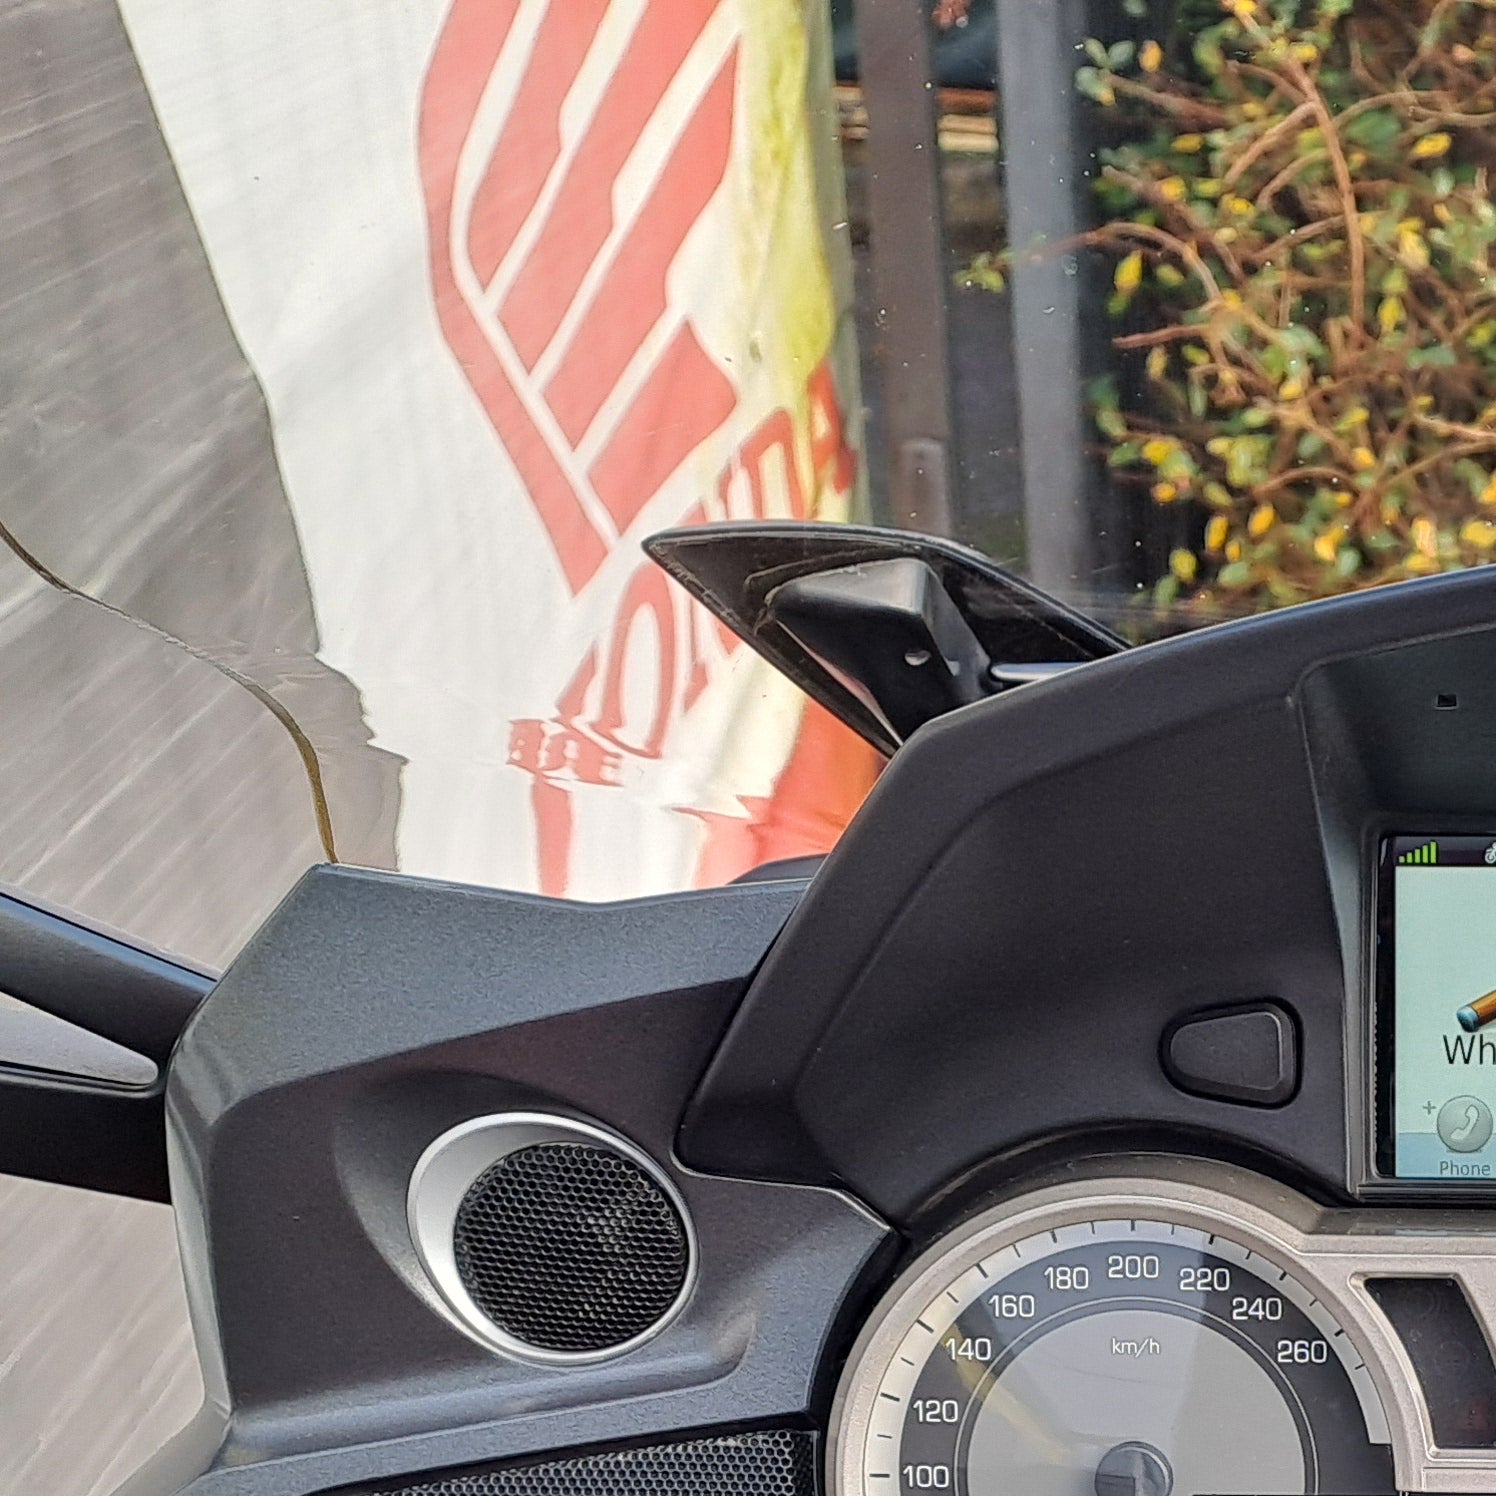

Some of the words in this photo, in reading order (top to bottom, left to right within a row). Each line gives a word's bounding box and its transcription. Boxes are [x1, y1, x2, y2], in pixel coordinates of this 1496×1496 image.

[1439, 1160, 1491, 1176] Phone
[1044, 1267, 1089, 1290] 180
[1108, 1256, 1159, 1279] 200
[1179, 1268, 1230, 1291] 220
[989, 1295, 1035, 1318] 160
[1232, 1298, 1281, 1321] 240
[946, 1338, 991, 1361] 140
[1112, 1338, 1161, 1356] km/h
[1277, 1341, 1327, 1364] 260
[913, 1400, 958, 1423] 120
[903, 1466, 949, 1488] 100
